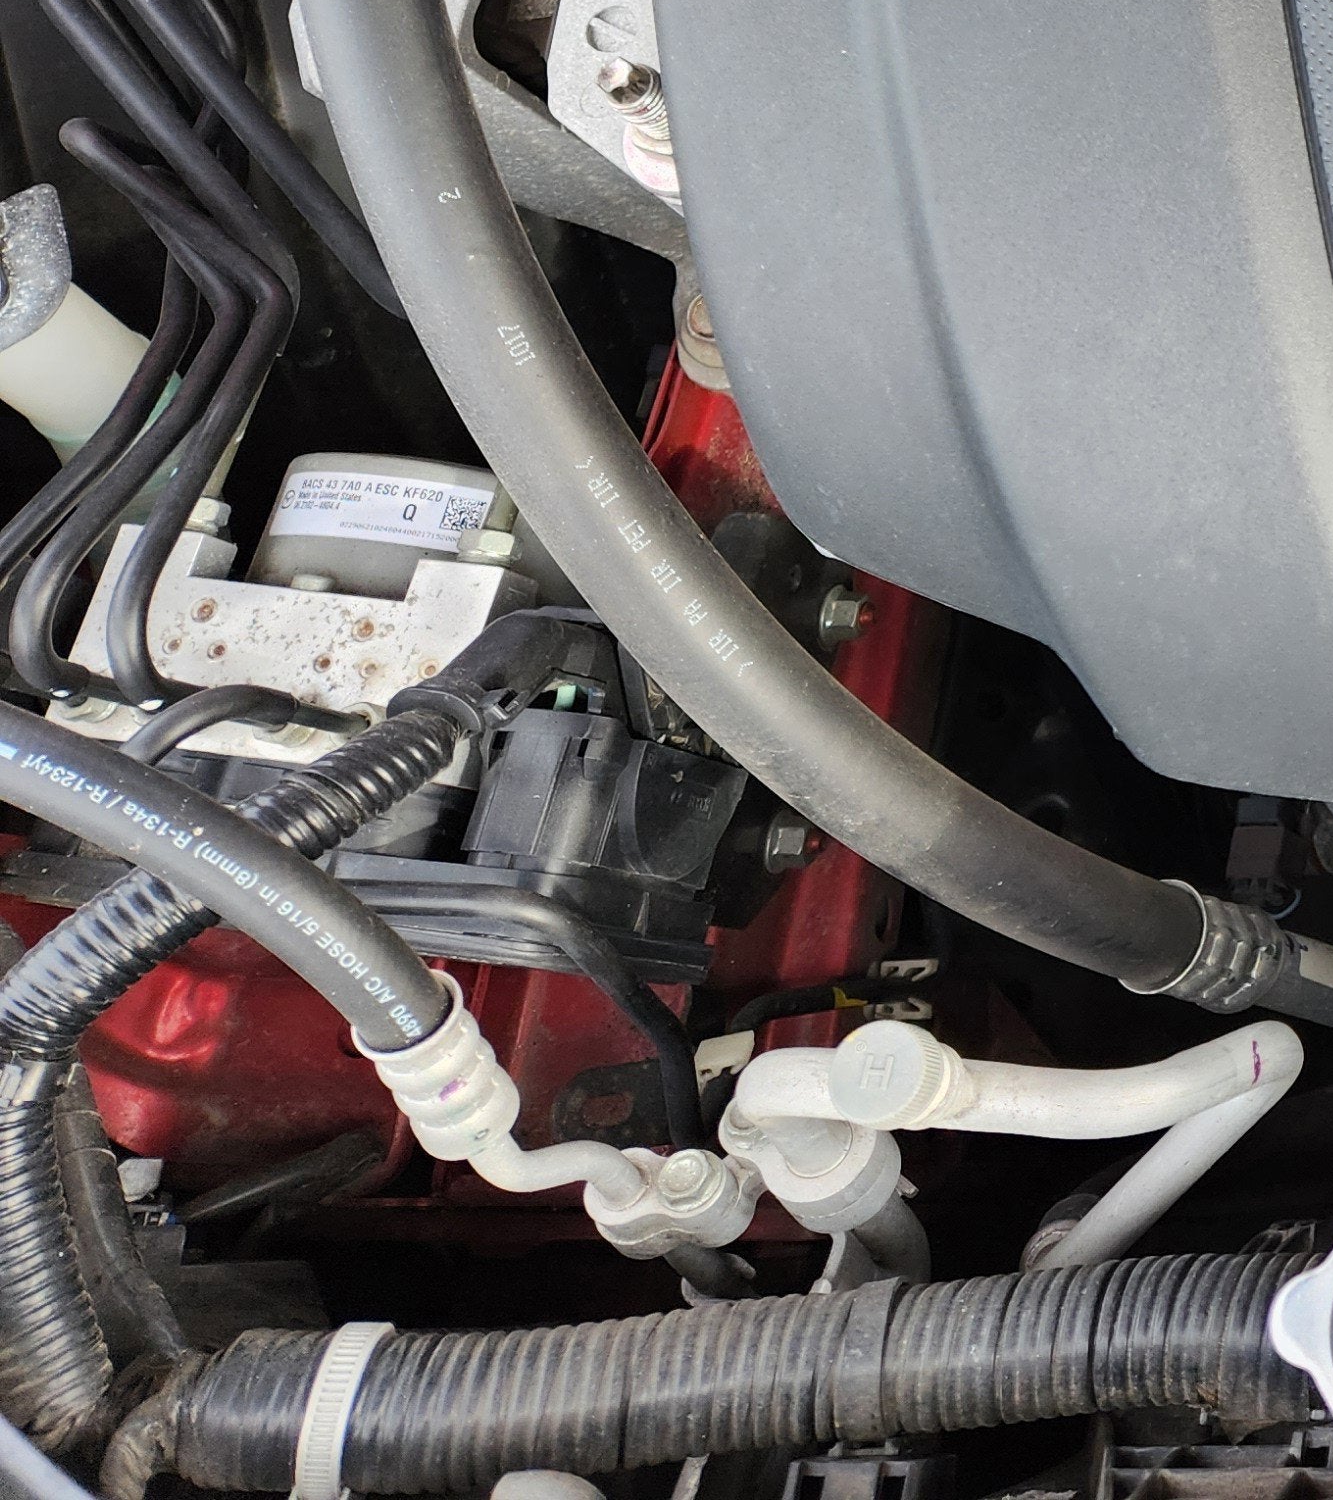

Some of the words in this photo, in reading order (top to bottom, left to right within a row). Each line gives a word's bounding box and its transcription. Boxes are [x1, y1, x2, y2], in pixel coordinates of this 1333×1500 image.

[365, 482, 373, 493] A
[375, 483, 400, 496] ESC
[403, 486, 444, 502] KF620
[587, 472, 620, 508] IIR
[402, 503, 418, 522] Q
[618, 517, 652, 554] PET
[650, 557, 682, 594] IIR
[684, 599, 708, 626] PA
[20, 752, 102, 804] R-1234yf
[122, 803, 189, 849] R-134a
[193, 842, 260, 892] (8mm)
[258, 885, 284, 908] in
[277, 899, 321, 940] 5/16
[315, 932, 372, 980] HOSE
[363, 976, 398, 1005] A/C
[389, 1003, 424, 1039] 4890
[860, 1052, 895, 1091] H
